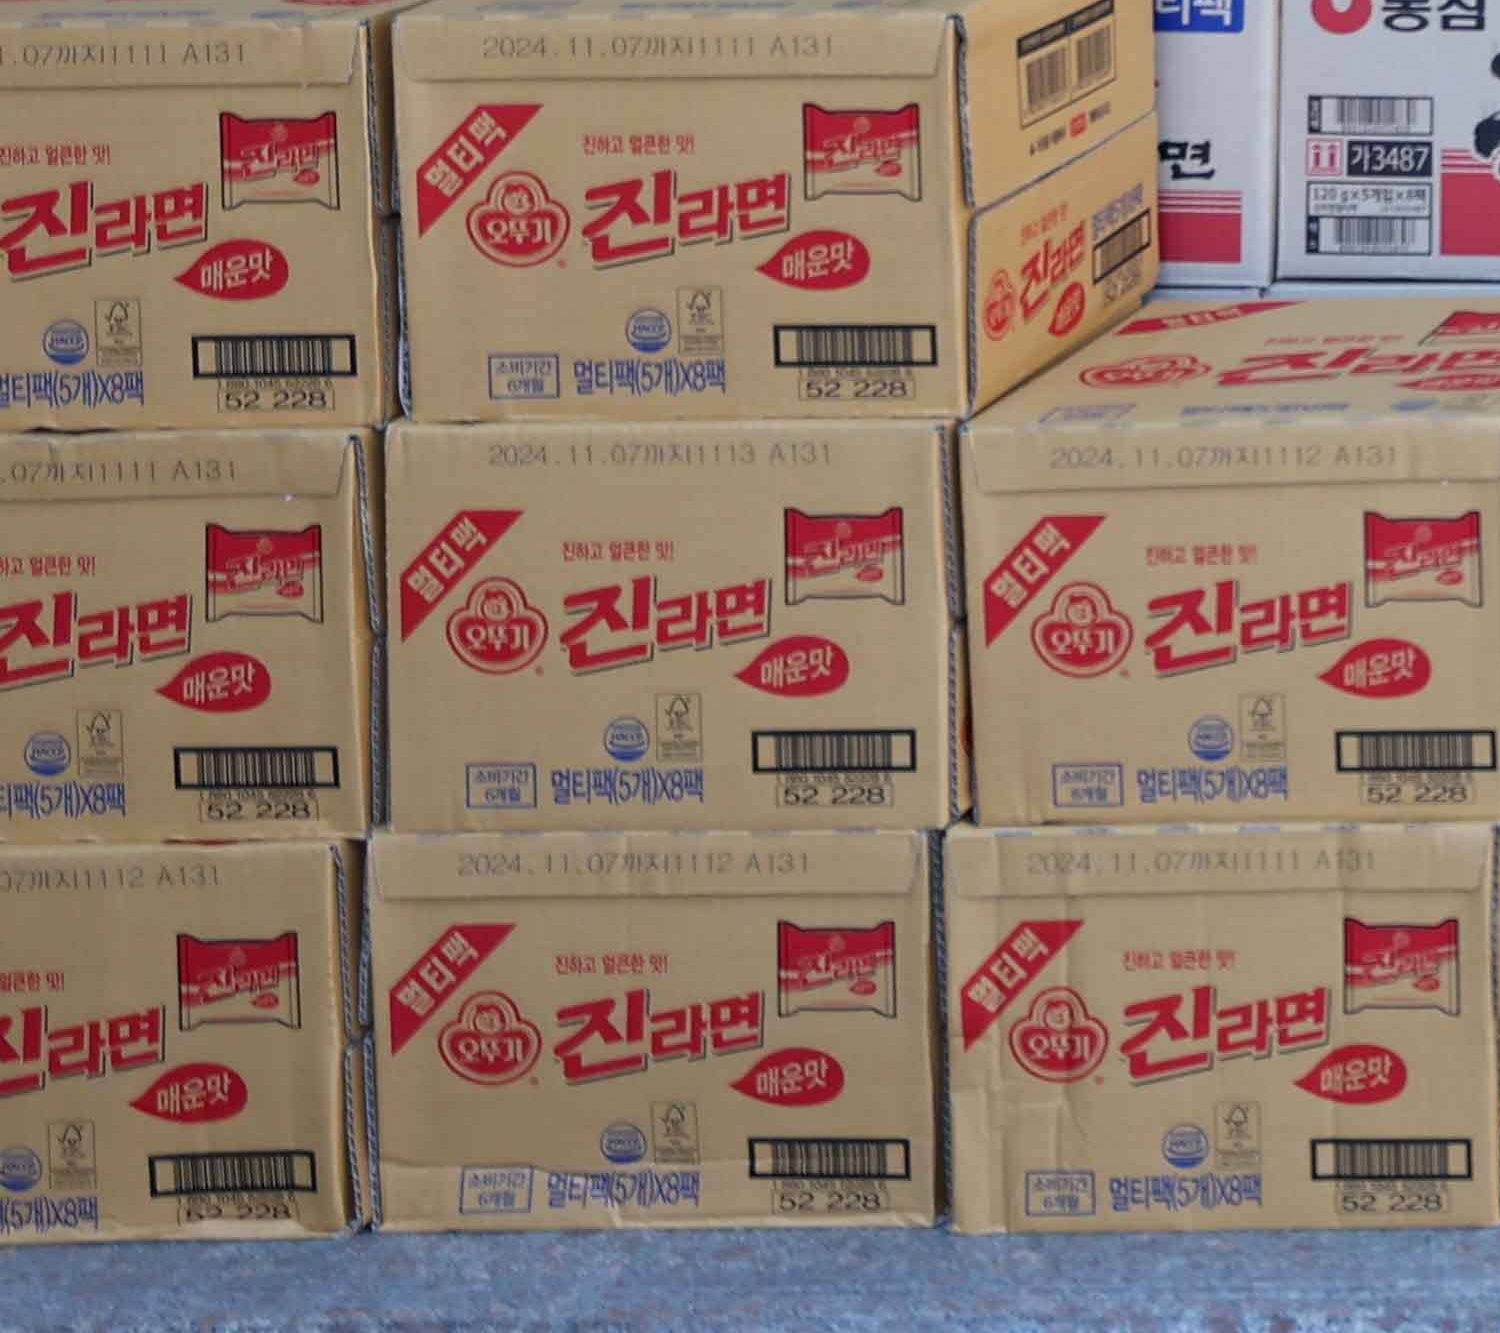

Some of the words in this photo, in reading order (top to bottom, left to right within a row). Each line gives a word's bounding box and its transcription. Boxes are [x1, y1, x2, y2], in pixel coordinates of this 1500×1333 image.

[770, 37, 835, 57] A131
[425, 110, 508, 197] 멀티팩
[583, 134, 623, 155] 진하고
[629, 134, 671, 155] 얼큰한
[676, 134, 694, 154] 맛!
[484, 218, 553, 245] 오뚜기
[582, 168, 791, 270] 진라면
[782, 240, 855, 281] 매운맛
[805, 381, 842, 399] 52
[853, 381, 908, 398] 228
